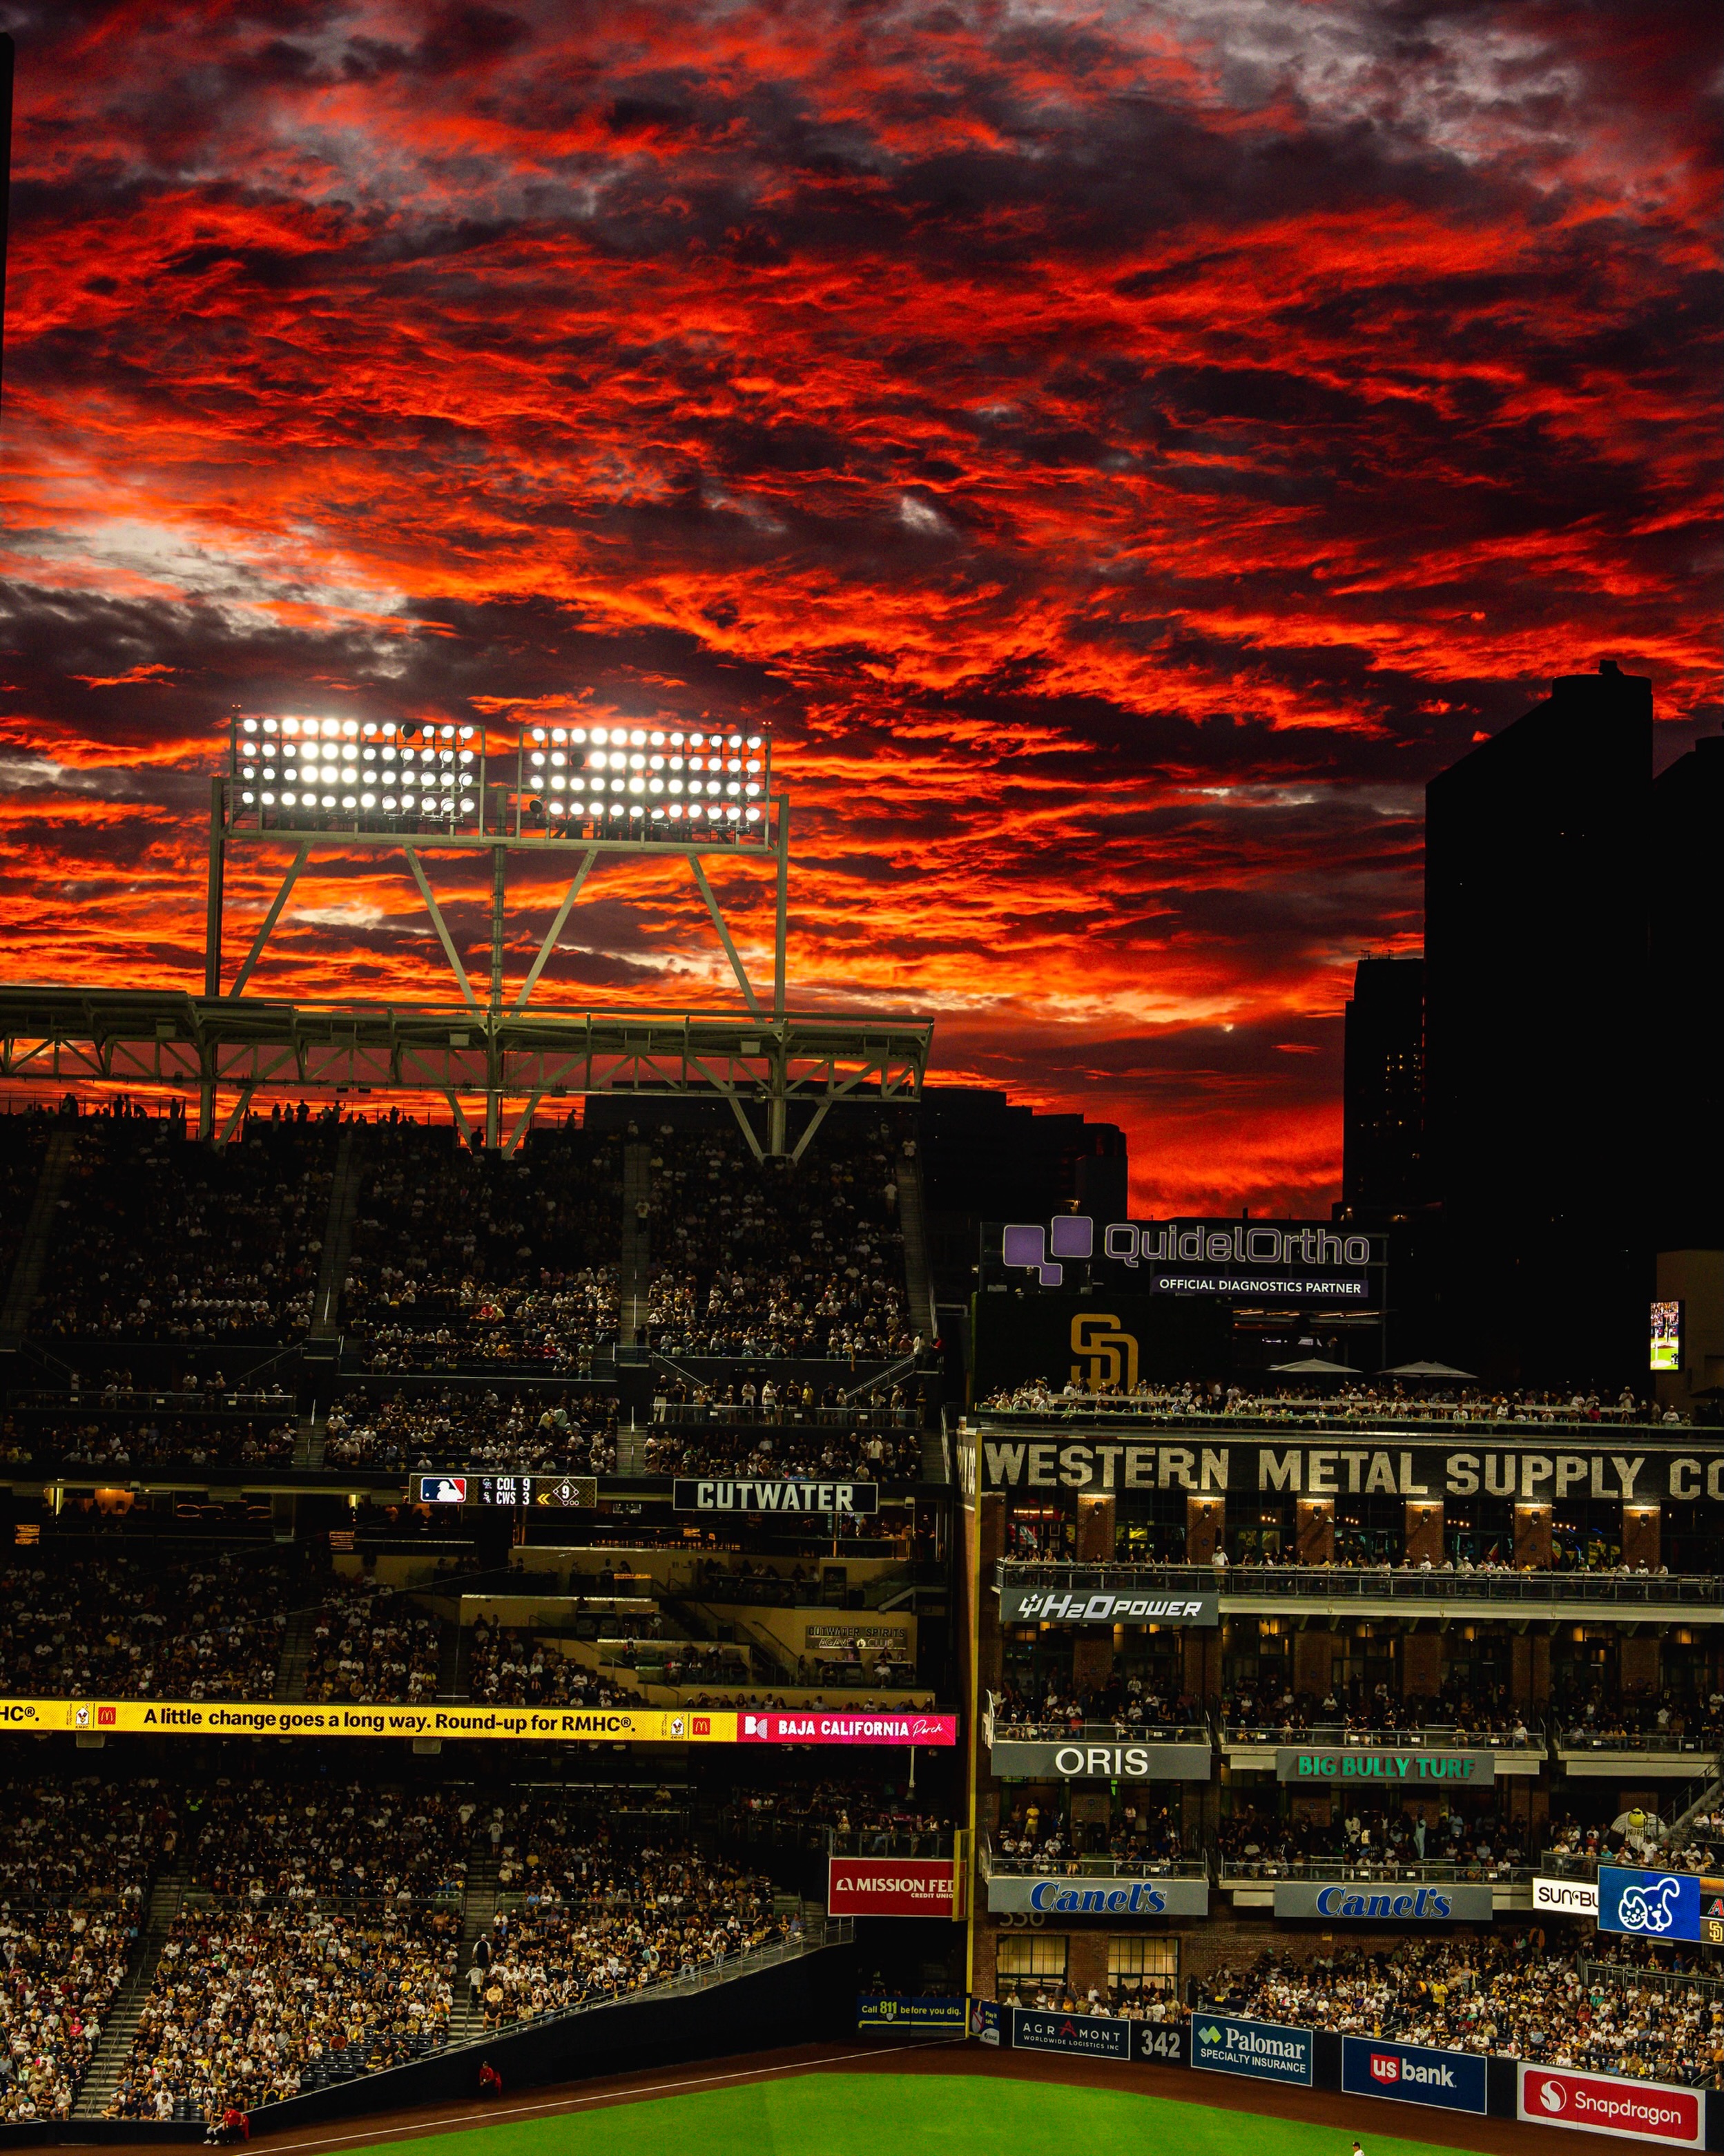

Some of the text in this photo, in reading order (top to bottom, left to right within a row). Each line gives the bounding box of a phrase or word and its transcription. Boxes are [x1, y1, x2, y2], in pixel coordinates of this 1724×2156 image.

[1104, 1223, 1370, 1267] QuidelOrtho
[1159, 1279, 1361, 1293] OFFICIAL DIAGNOSTICS PARTNER
[985, 1443, 1229, 1491] WESTERN
[1259, 1450, 1428, 1494] METAL
[1446, 1454, 1645, 1499] SUPPLY
[497, 1477, 530, 1491] COL 9
[562, 1485, 570, 1499] 9
[496, 1491, 530, 1505] CWS 3
[697, 1482, 853, 1512] CUTWATER
[808, 1626, 904, 1637] CUTWATER SPIRITS
[867, 1638, 893, 1647] CLUB
[144, 1708, 157, 1724] A
[161, 1708, 202, 1725] little
[209, 1709, 276, 1730] change
[279, 1714, 325, 1731] goes
[328, 1715, 339, 1727] a
[345, 1712, 385, 1731] long
[388, 1717, 431, 1733] way.
[436, 1713, 527, 1733] Round-up
[531, 1715, 557, 1731] for
[779, 1720, 815, 1735] BAJA
[821, 1720, 909, 1736] CALIFORNIA
[1055, 1747, 1149, 1775] ORIS
[1297, 1755, 1475, 1779] BIG BULLY TURF
[856, 1878, 924, 1892] MISSION
[1029, 1881, 1168, 1914] Canel's
[1316, 1886, 1453, 1918] Canel's
[862, 2005, 878, 2013] Call
[879, 2001, 898, 2014] 811
[929, 2008, 945, 2016] you
[947, 2007, 962, 2017] dig.
[1023, 2019, 1120, 2042] AGRAMONT
[1023, 2035, 1066, 2045] WORLDWIDE
[1069, 2040, 1105, 2049] LOGISTICS
[1141, 2029, 1181, 2059] 342
[1226, 2027, 1306, 2059] Palomar
[1200, 2048, 1306, 2074] SPECIALTY INSURANCE
[1373, 2058, 1455, 2088] us bank
[1575, 2090, 1681, 2125] Snapdragon
